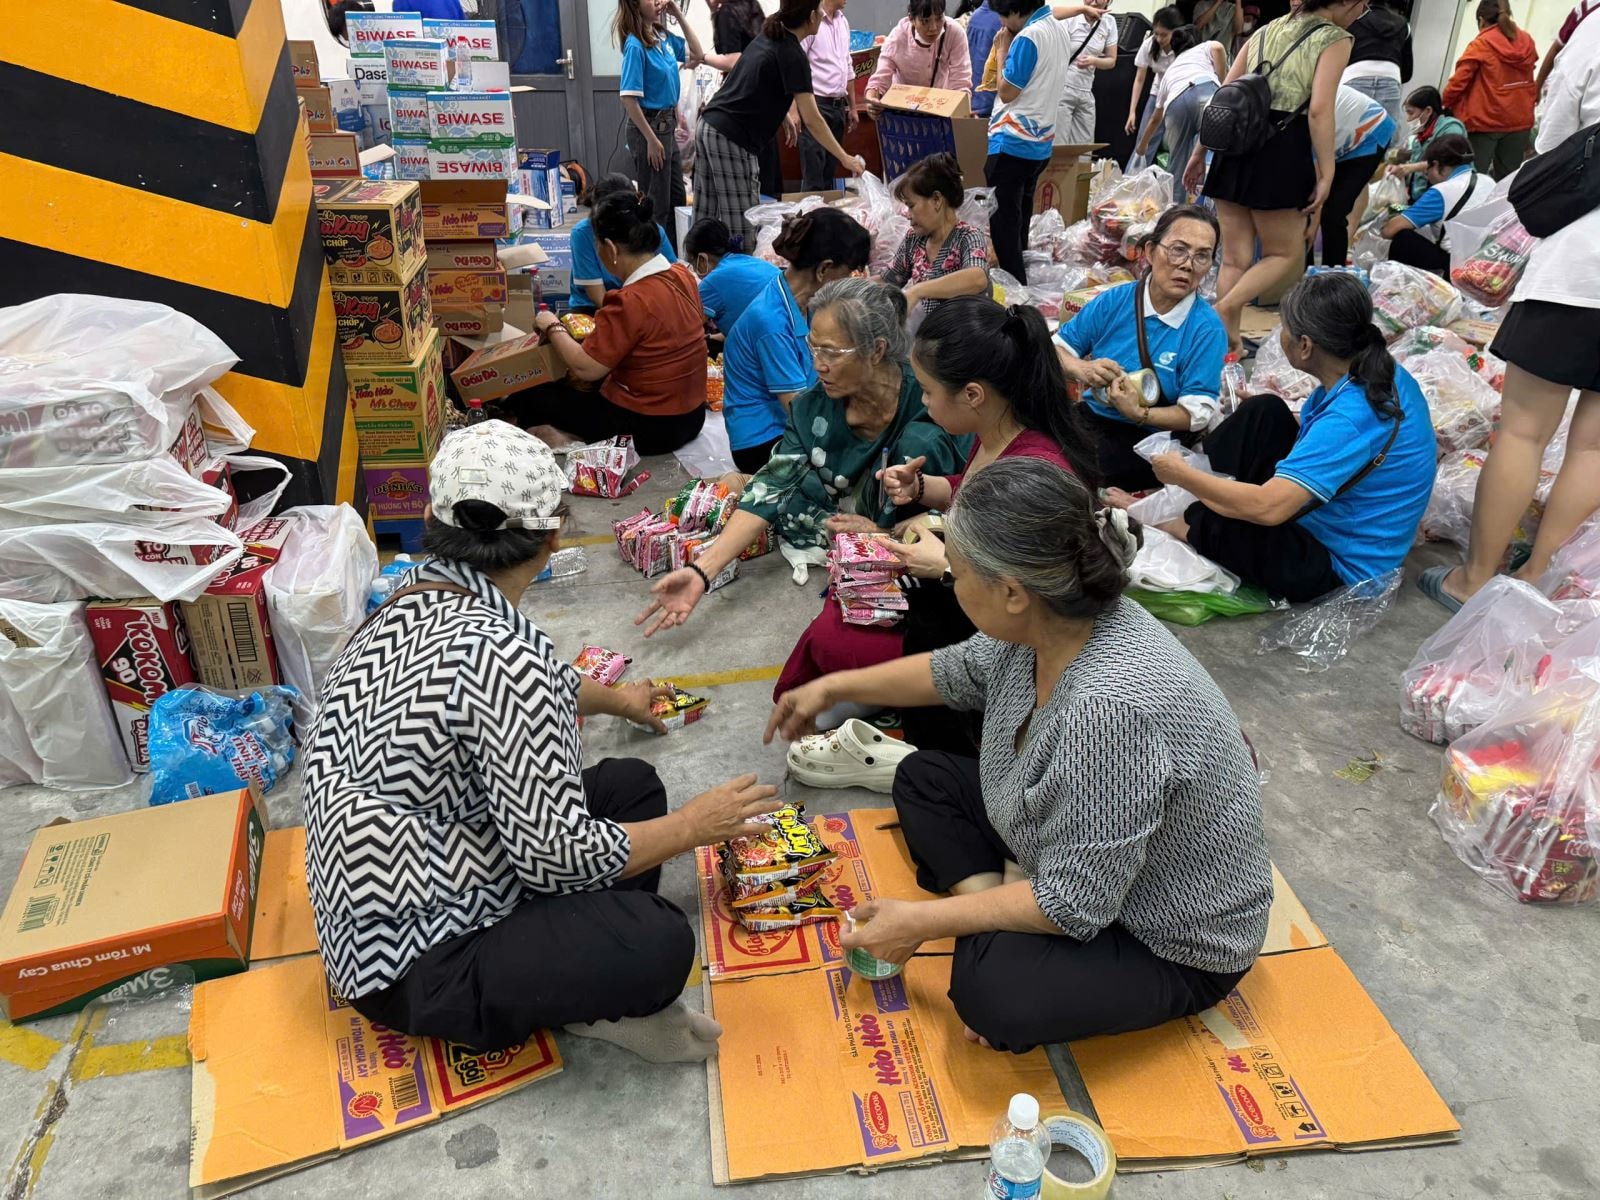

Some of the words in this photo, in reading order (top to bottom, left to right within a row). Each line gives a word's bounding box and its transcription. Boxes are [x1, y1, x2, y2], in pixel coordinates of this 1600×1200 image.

[356, 31, 416, 41] BIWASE
[391, 59, 438, 70] BIWASE
[396, 109, 428, 118] BIWA
[437, 112, 505, 126] BIWASE
[400, 157, 429, 165] BIWA
[437, 162, 503, 173] BIWASE
[112, 657, 137, 684] 90
[95, 948, 130, 962] Tôm
[51, 957, 92, 972] Chua
[18, 966, 48, 980] Cay
[854, 1014, 886, 1048] Hảo
[376, 1034, 416, 1069] Hảo
[455, 1058, 487, 1086] gói
[868, 1049, 902, 1086] Hảo
